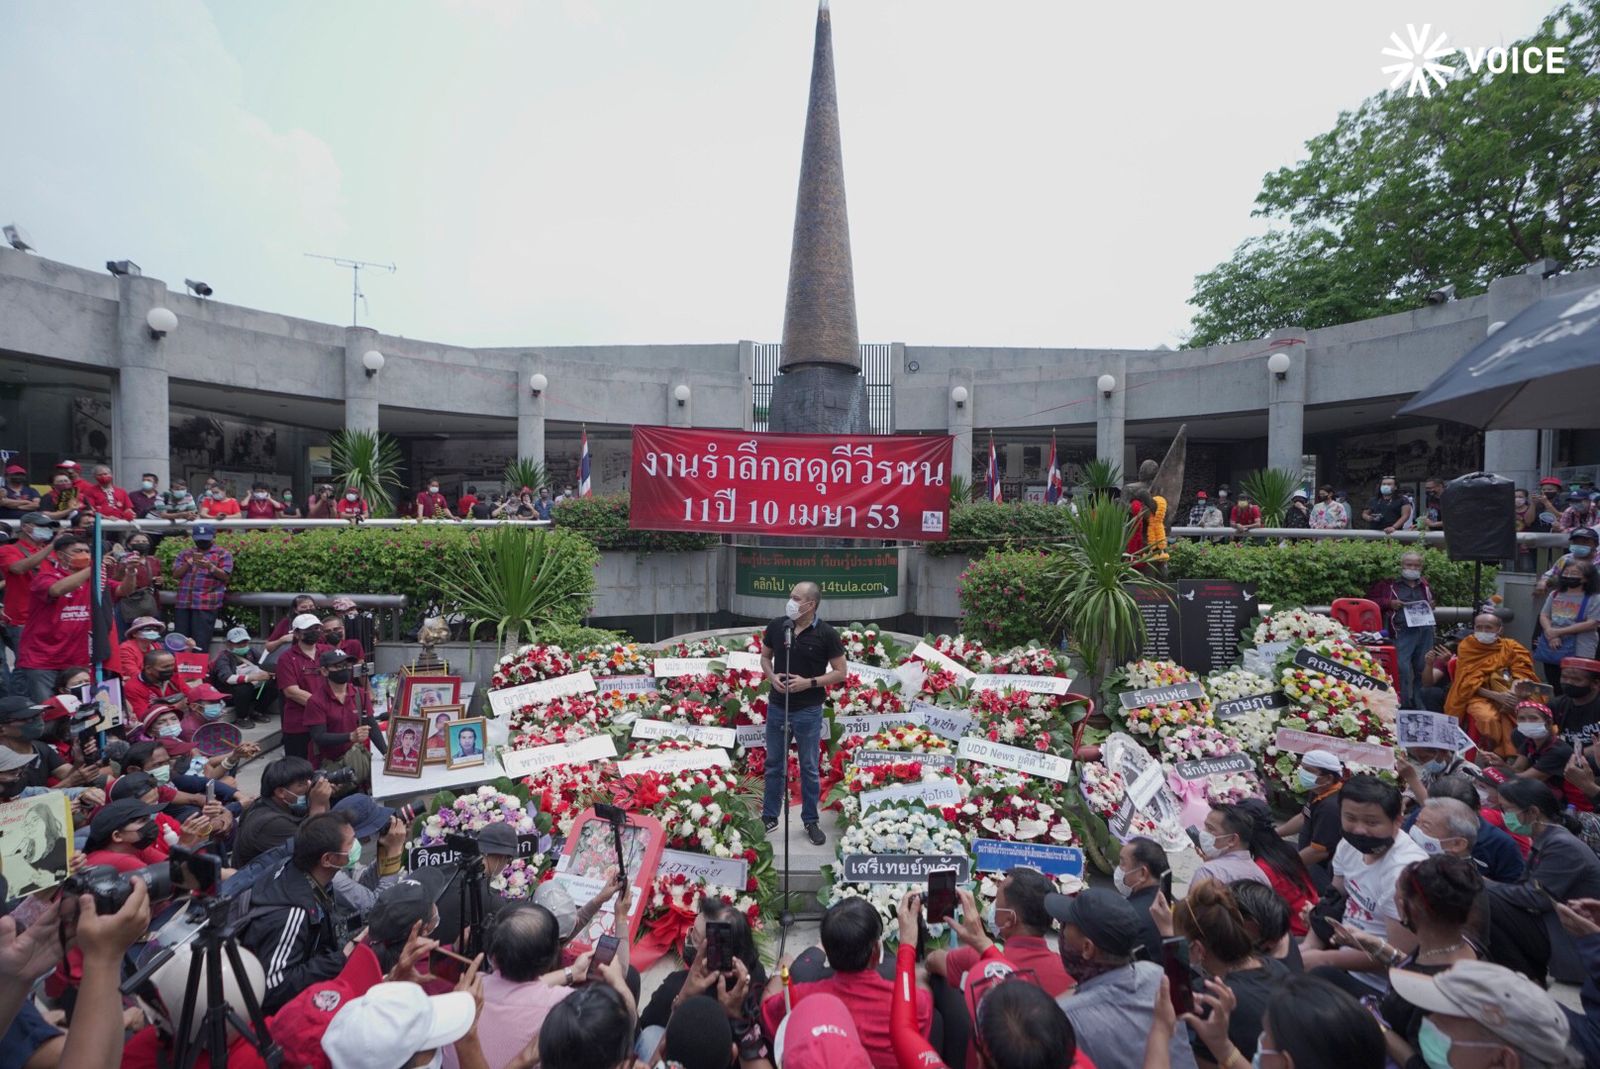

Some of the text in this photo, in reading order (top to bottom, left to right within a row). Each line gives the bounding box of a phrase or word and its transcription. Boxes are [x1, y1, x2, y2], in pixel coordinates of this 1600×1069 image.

[642, 440, 944, 494] งานรำลึกสดุดีวีรชน
[683, 487, 900, 529] 11ปี 10 เมษา 53
[788, 581, 883, 593] w14tula.com
[1220, 695, 1273, 714] ราษฎร
[966, 743, 988, 756] UDD
[989, 748, 1016, 762] News
[1183, 759, 1245, 776] นักเรียนเลว
